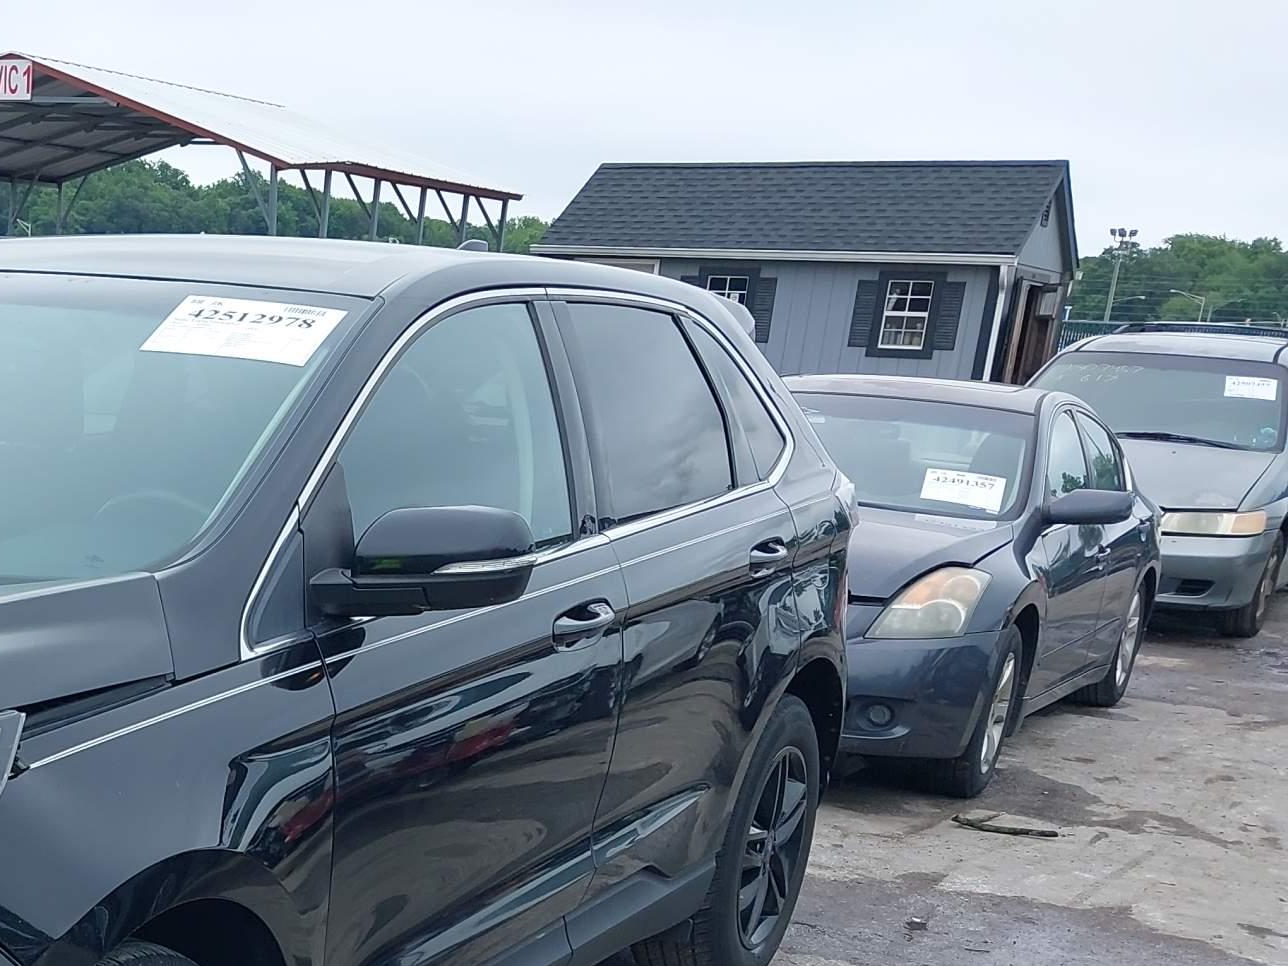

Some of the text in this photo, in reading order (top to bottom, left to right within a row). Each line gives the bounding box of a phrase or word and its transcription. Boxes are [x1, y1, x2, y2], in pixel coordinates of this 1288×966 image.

[23, 65, 31, 94] 1
[188, 308, 316, 329] 42512978
[932, 476, 995, 490] 42491357
